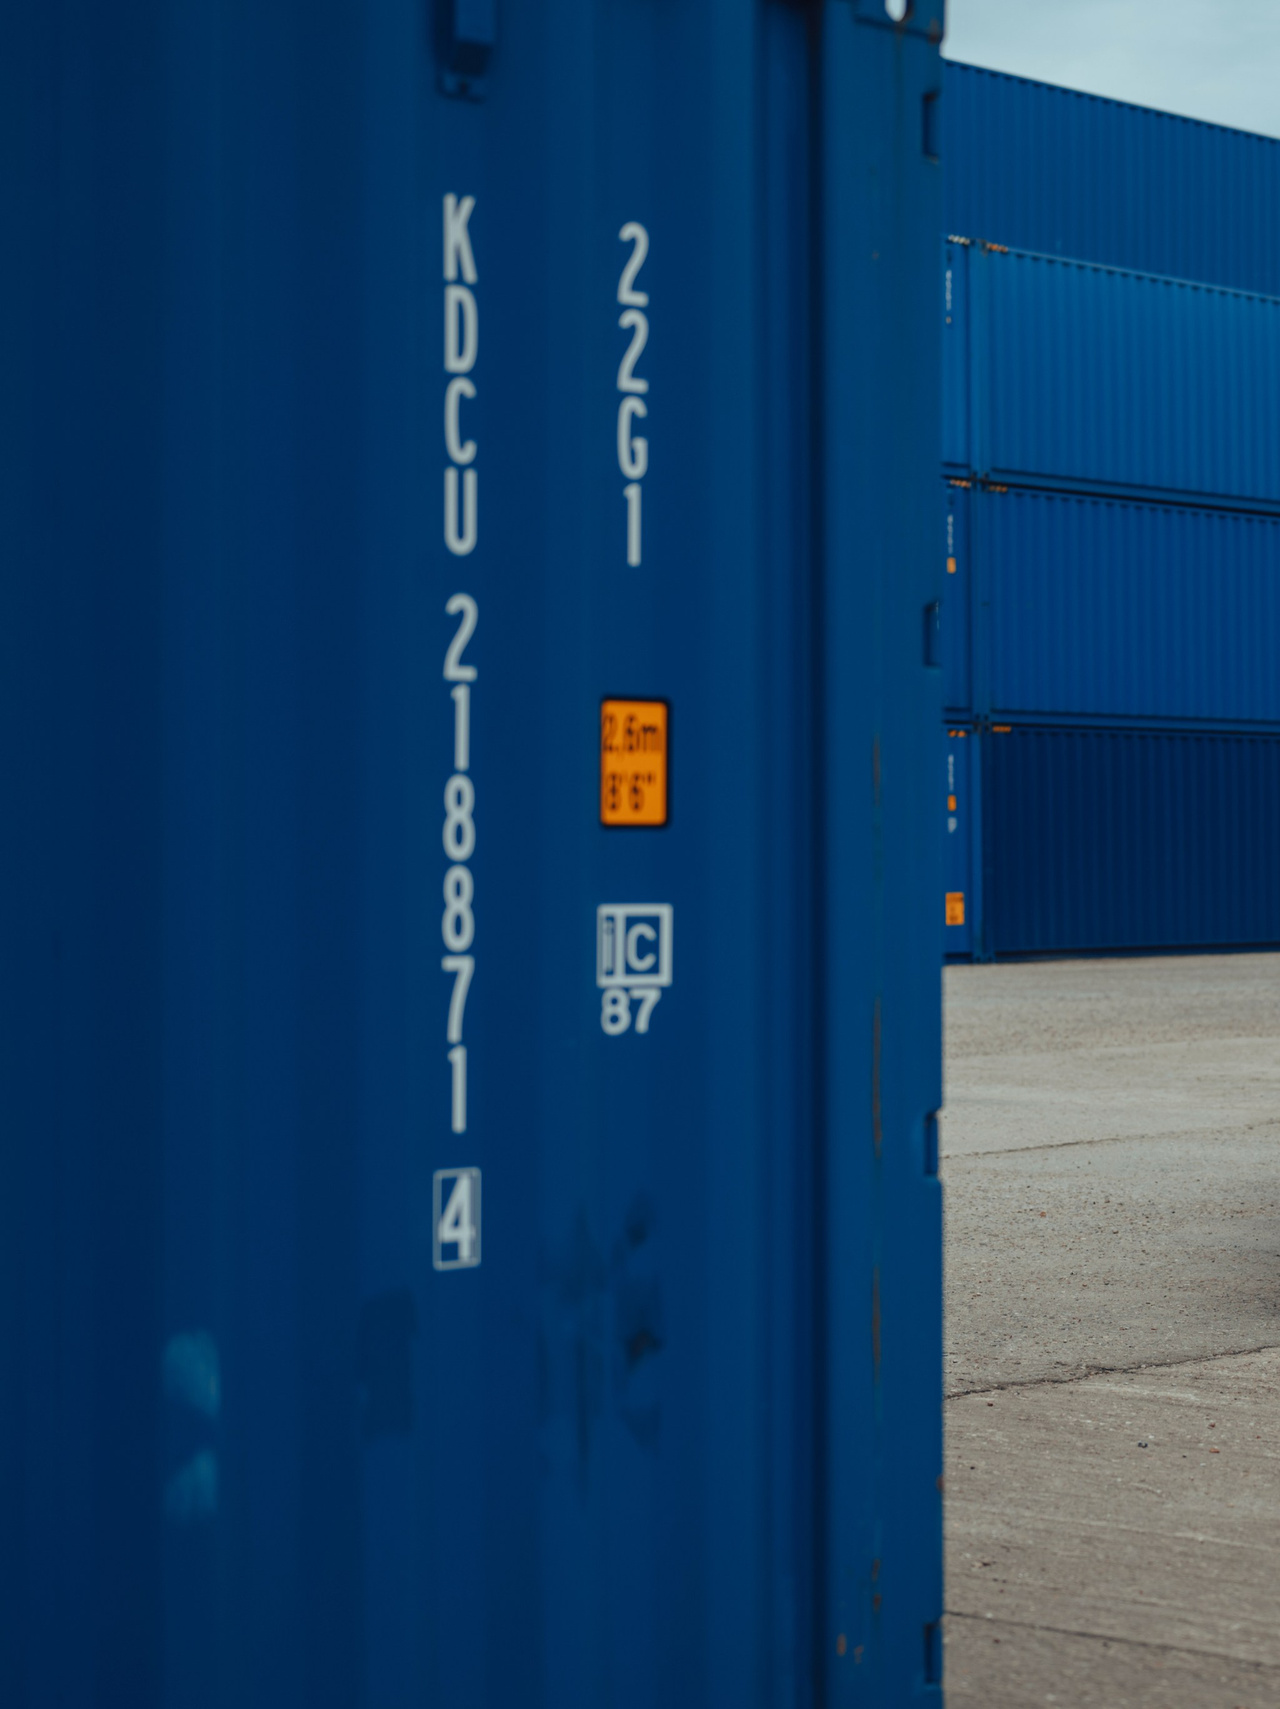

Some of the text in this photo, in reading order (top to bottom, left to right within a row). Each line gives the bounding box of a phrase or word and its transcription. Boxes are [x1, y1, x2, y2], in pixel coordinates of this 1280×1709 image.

[616, 220, 650, 567] 22G1
[436, 192, 479, 1264] KDCU 218871 4
[600, 985, 662, 1036] 87
